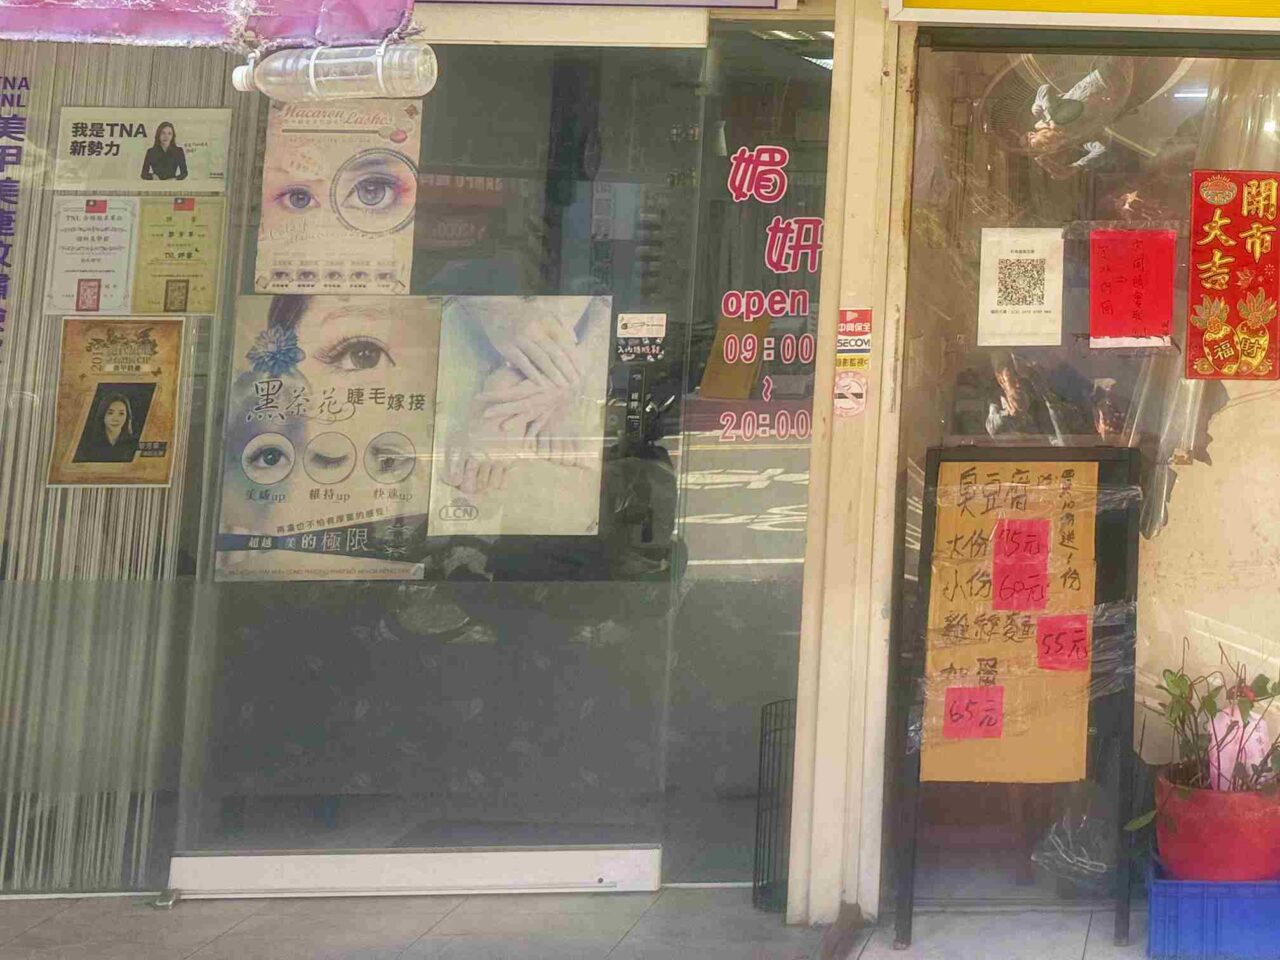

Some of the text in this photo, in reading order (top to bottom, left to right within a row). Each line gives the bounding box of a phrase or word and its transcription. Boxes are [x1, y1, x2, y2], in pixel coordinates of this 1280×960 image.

[0, 93, 26, 108] NL
[71, 121, 148, 139] 我是TNA
[69, 140, 121, 157] 新勢力
[1238, 177, 1280, 263] 開市
[1196, 207, 1238, 292] 大吉
[721, 289, 809, 322] open
[722, 333, 815, 365] 09:00
[1213, 339, 1236, 361] 福
[1241, 339, 1262, 360] 財
[719, 410, 812, 442] 20:00
